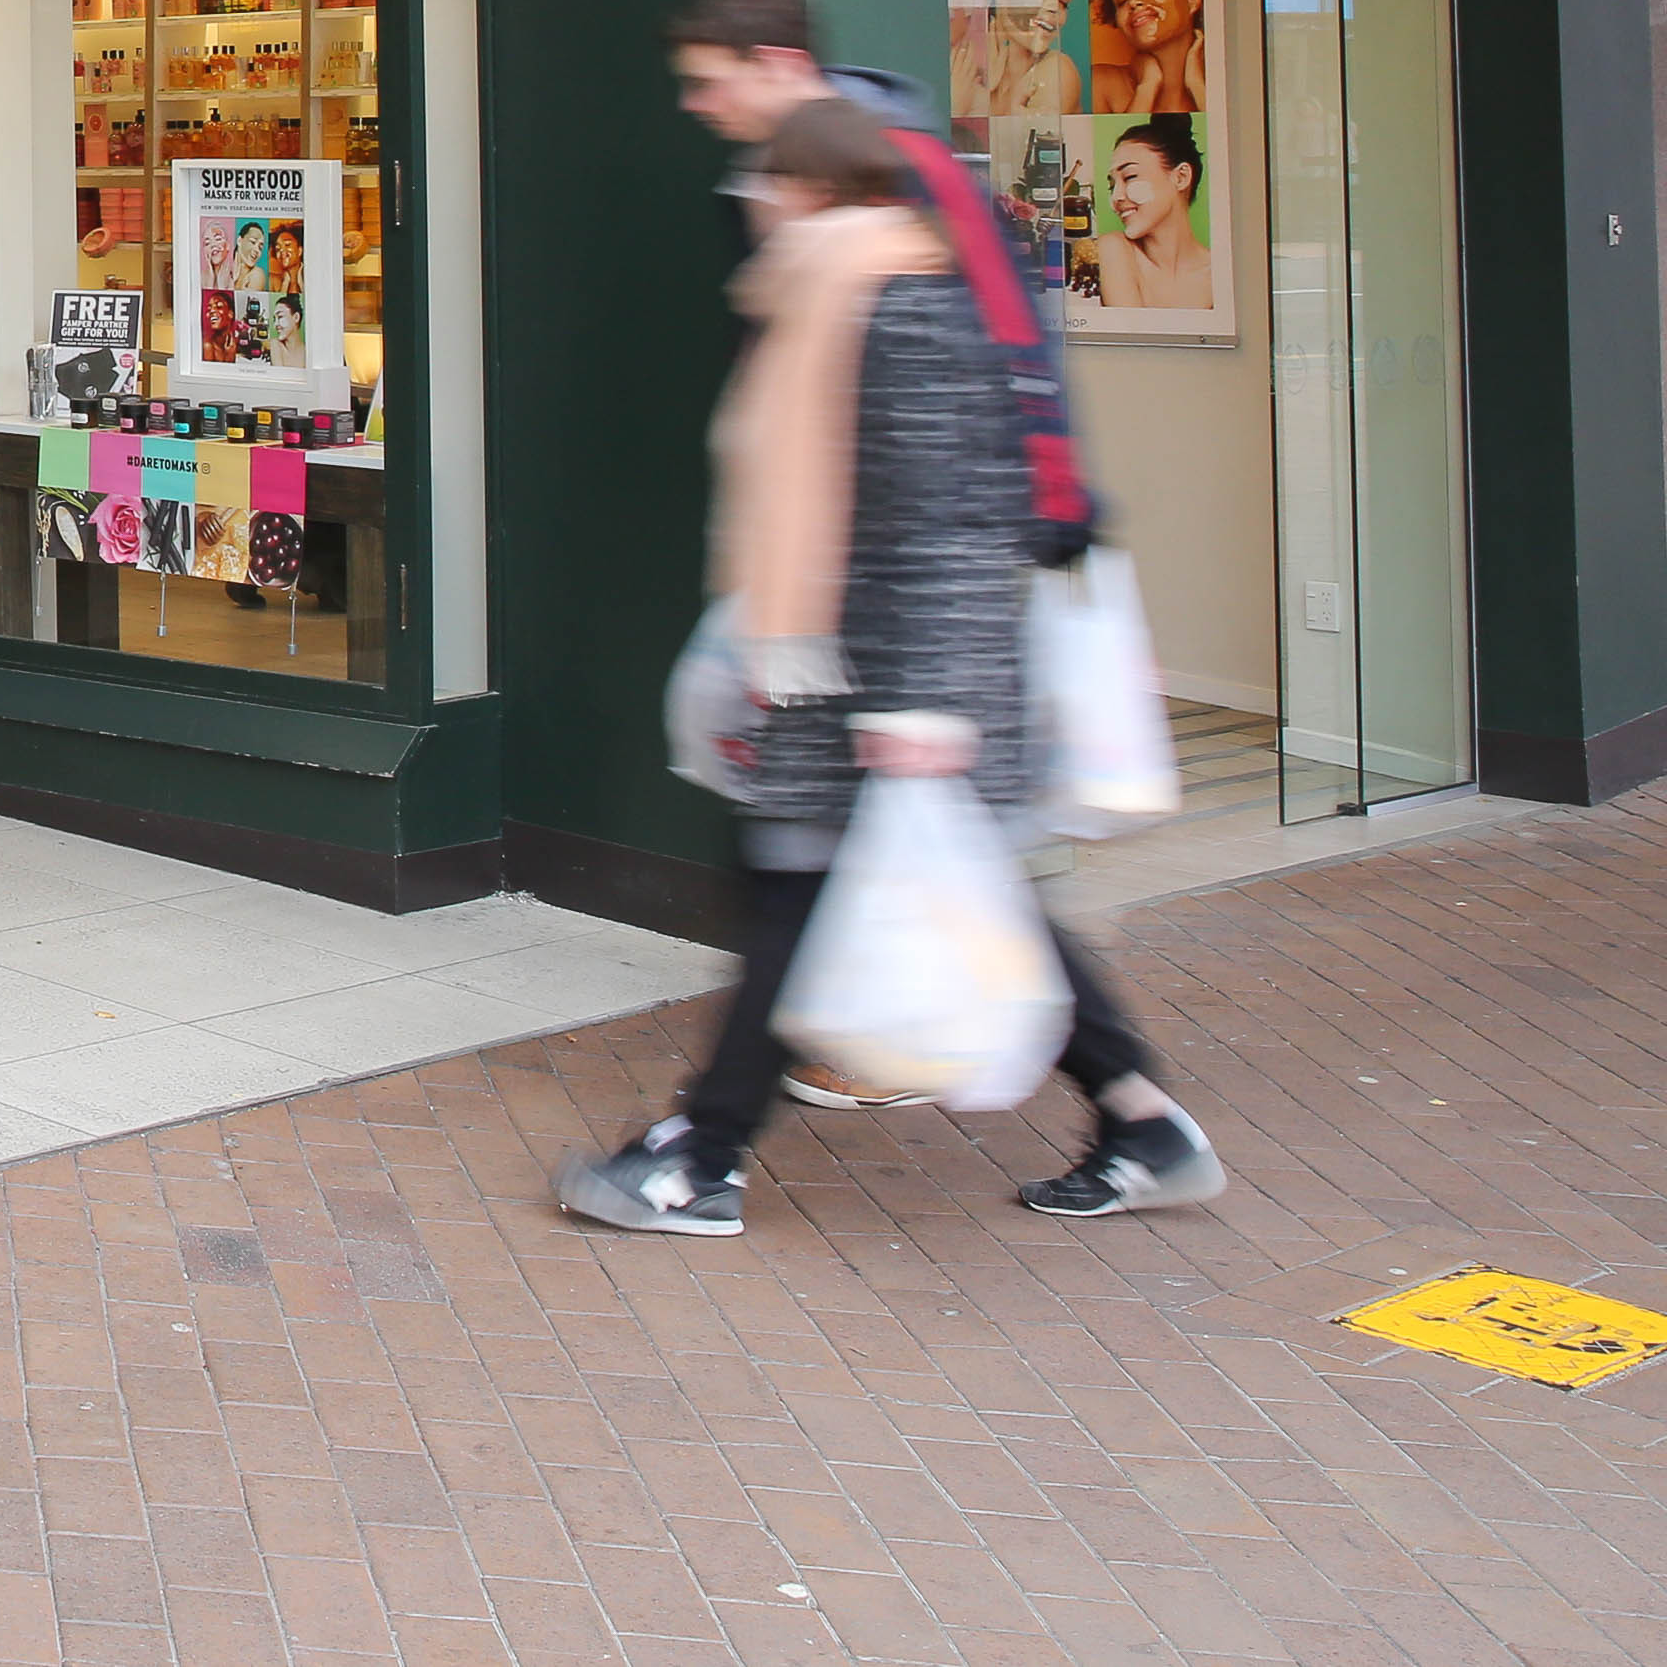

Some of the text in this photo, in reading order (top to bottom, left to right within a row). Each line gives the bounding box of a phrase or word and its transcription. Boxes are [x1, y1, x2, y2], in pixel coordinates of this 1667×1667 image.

[201, 168, 303, 190] SUPERFOOD
[204, 189, 300, 202] MASKS FOR YOUR FACE
[61, 294, 131, 322] FREE
[61, 319, 129, 329] PAMPER PARTNER
[60, 327, 129, 339] GIFT FOR YOU!
[126, 455, 199, 474] #DARETOMASK
